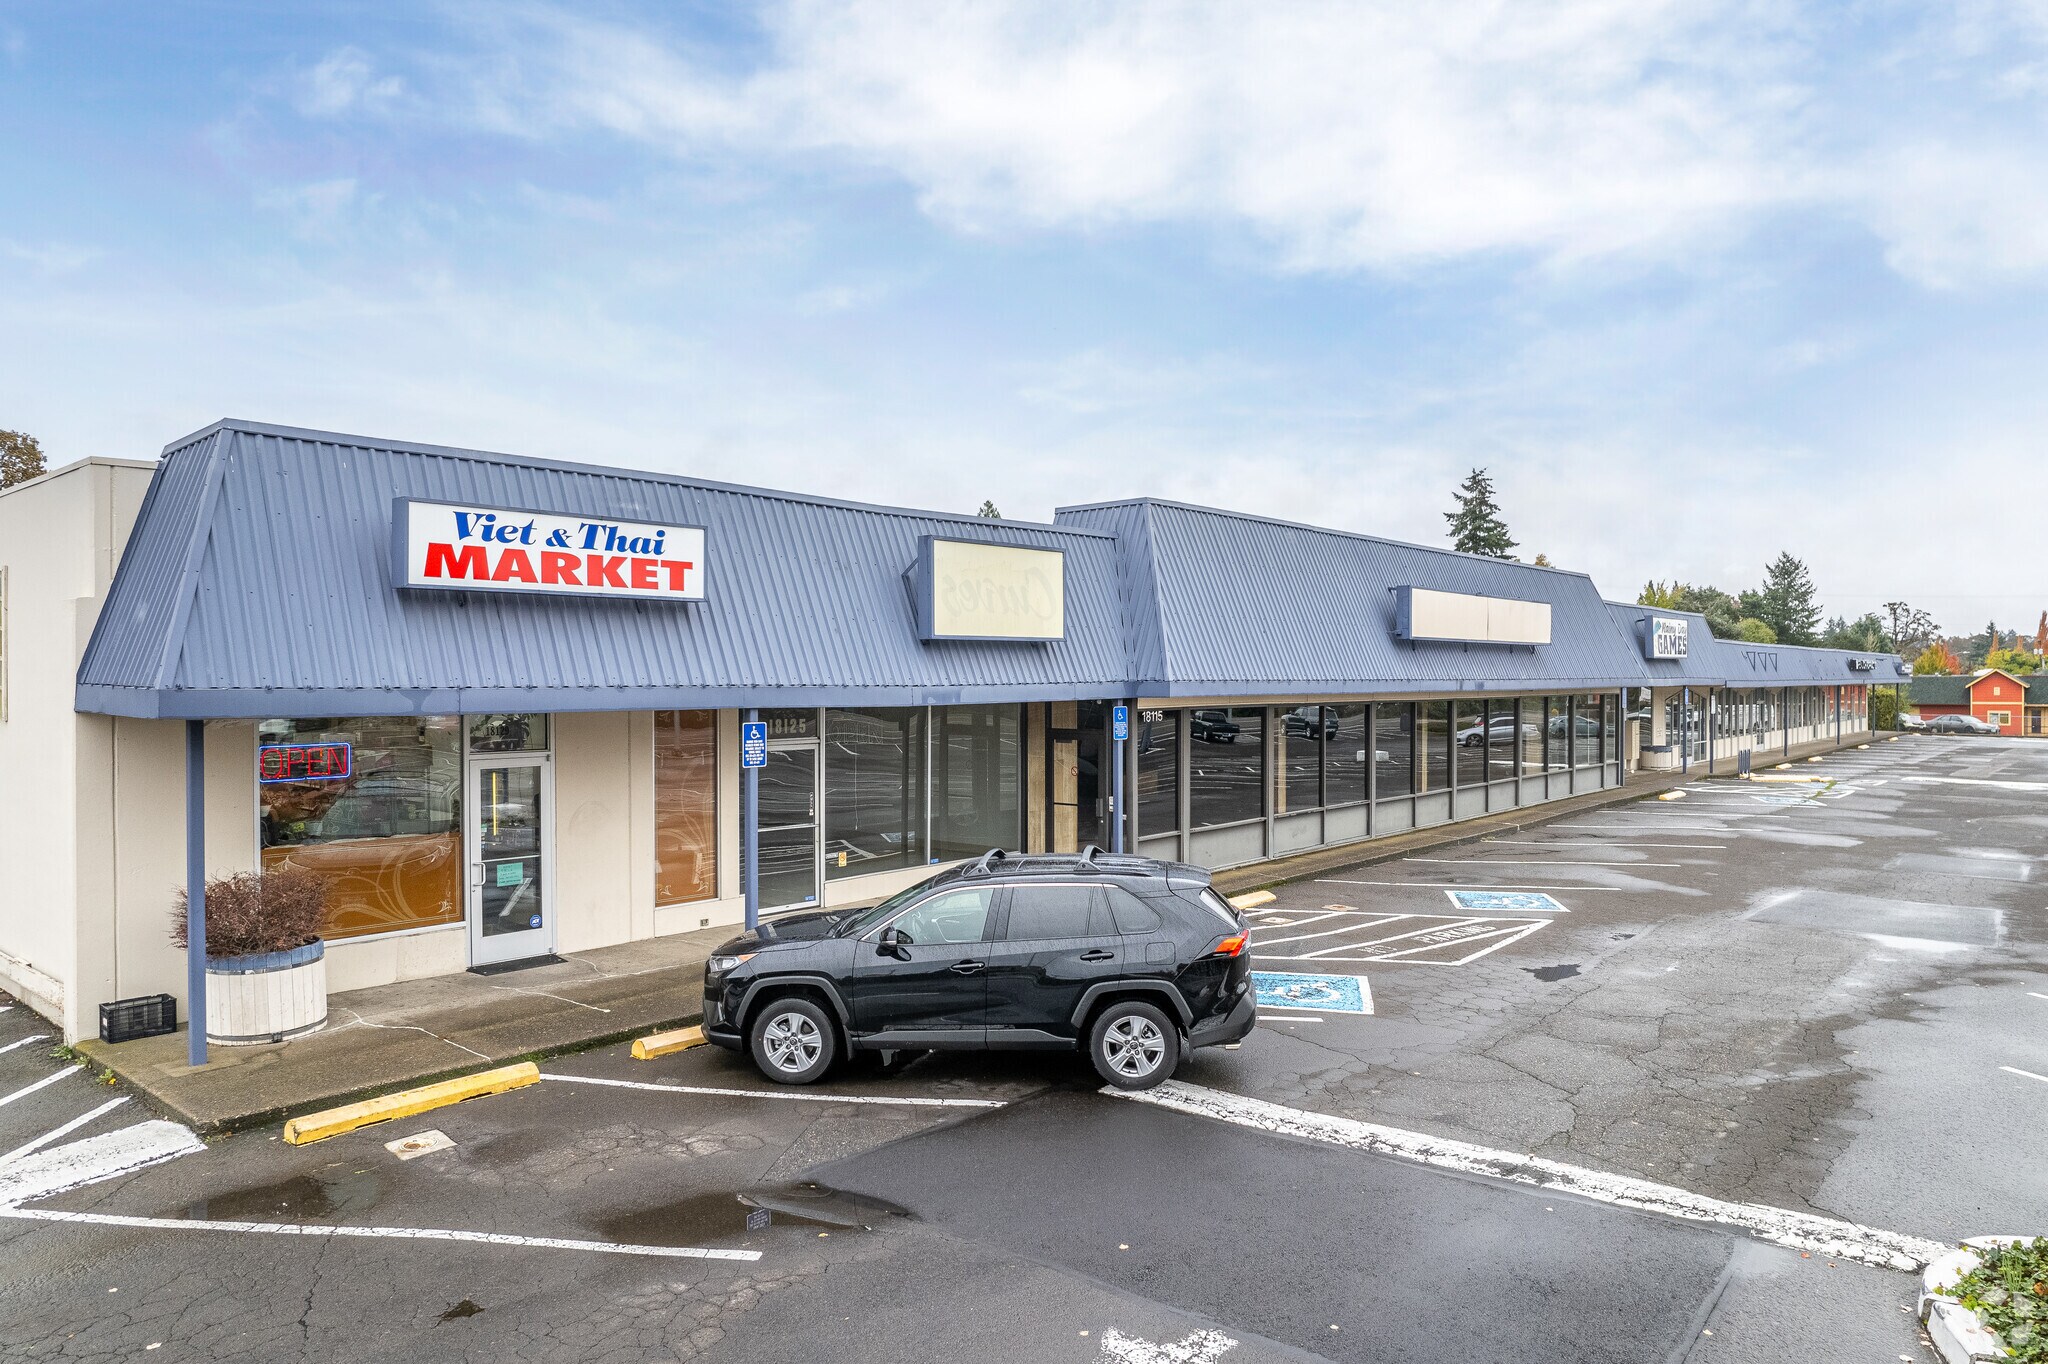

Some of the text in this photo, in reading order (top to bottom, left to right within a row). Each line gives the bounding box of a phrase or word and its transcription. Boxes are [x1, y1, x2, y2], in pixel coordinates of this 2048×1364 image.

[453, 511, 666, 555] Viet & Thai
[424, 543, 693, 591] MARKET
[1657, 634, 1687, 655] GAMES
[769, 718, 806, 734] 18125
[1142, 710, 1163, 722] 18115
[486, 725, 510, 736] 18129
[261, 746, 347, 778] OPEN
